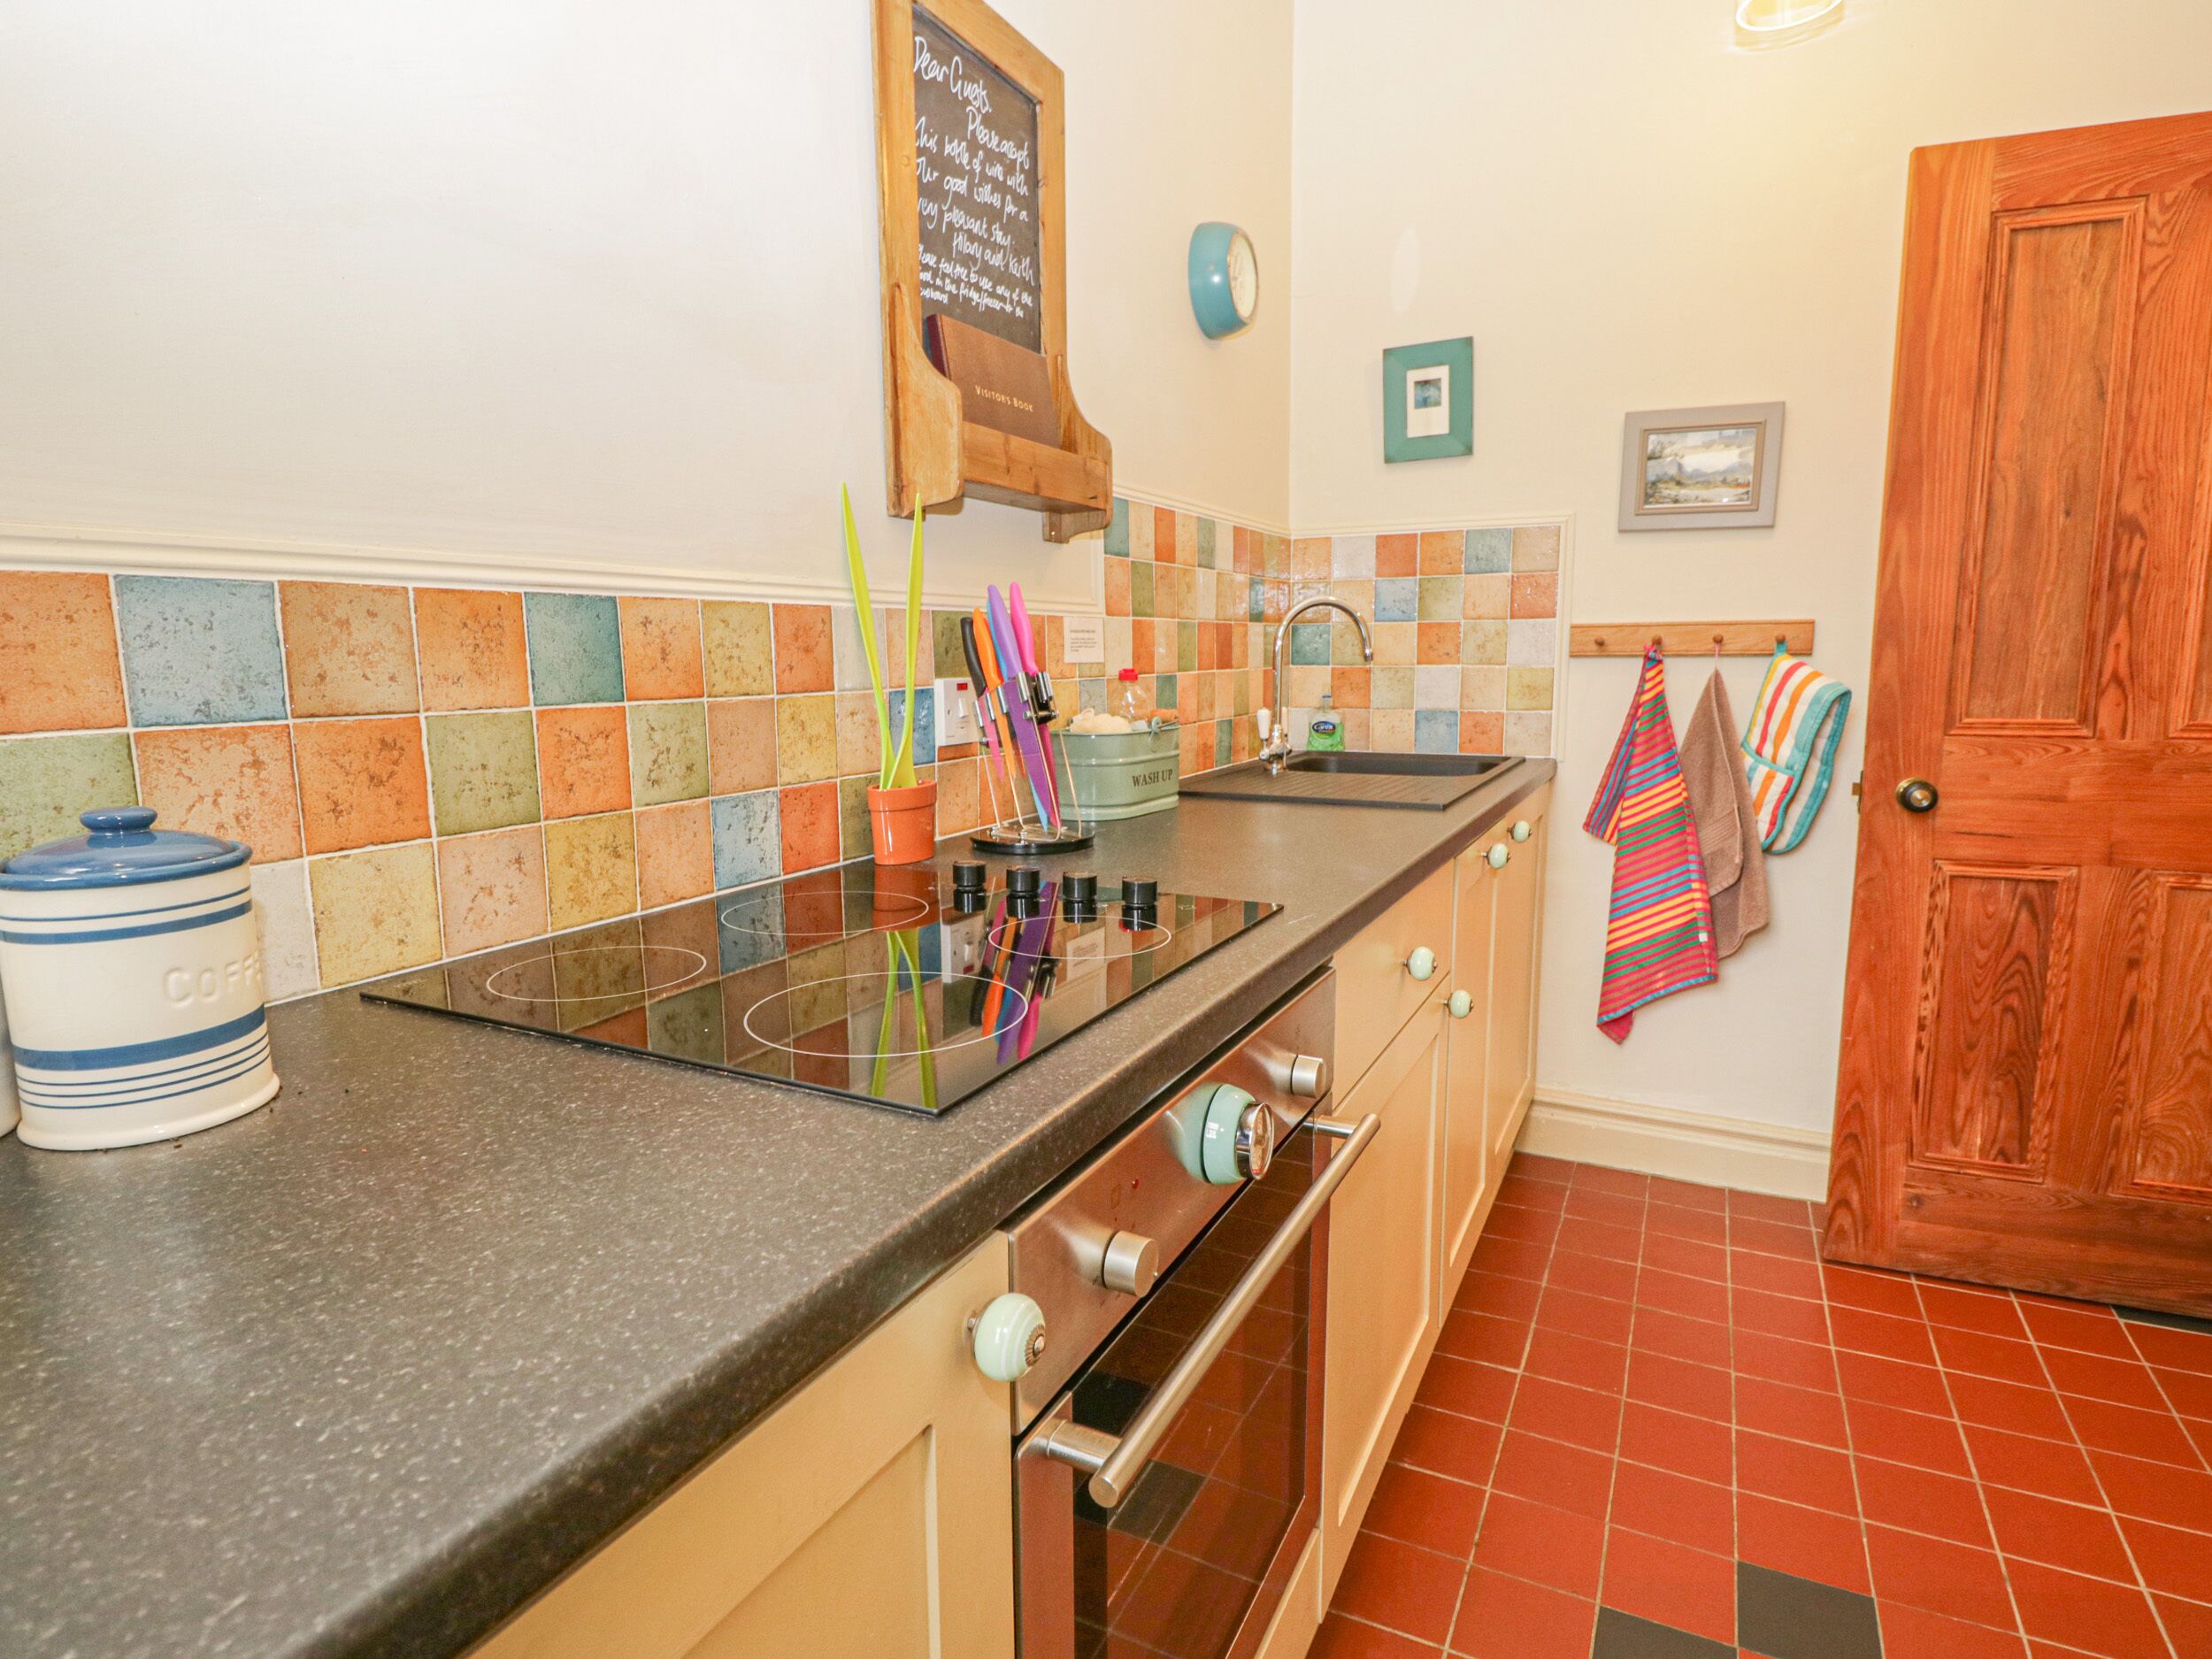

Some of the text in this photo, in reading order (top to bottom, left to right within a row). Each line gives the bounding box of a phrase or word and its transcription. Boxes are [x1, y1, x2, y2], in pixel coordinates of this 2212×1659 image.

[913, 35, 949, 82] Dear
[915, 116, 1029, 196] his bottle of wine with
[966, 106, 1030, 173] Please accept
[941, 175, 968, 211] good
[974, 183, 1002, 209] wishes
[1003, 195, 1018, 223] for
[1019, 211, 1029, 221] a
[942, 206, 988, 239] pleasant
[918, 243, 937, 268] lease
[970, 269, 978, 283] to
[979, 276, 993, 292] use
[996, 285, 1010, 307] any
[1021, 292, 1033, 307] the
[952, 231, 1035, 287] Hilary and Keith
[935, 277, 943, 288] in
[945, 277, 957, 295] the
[1013, 397, 1033, 412] BOOK
[1132, 769, 1173, 787] WASH UP
